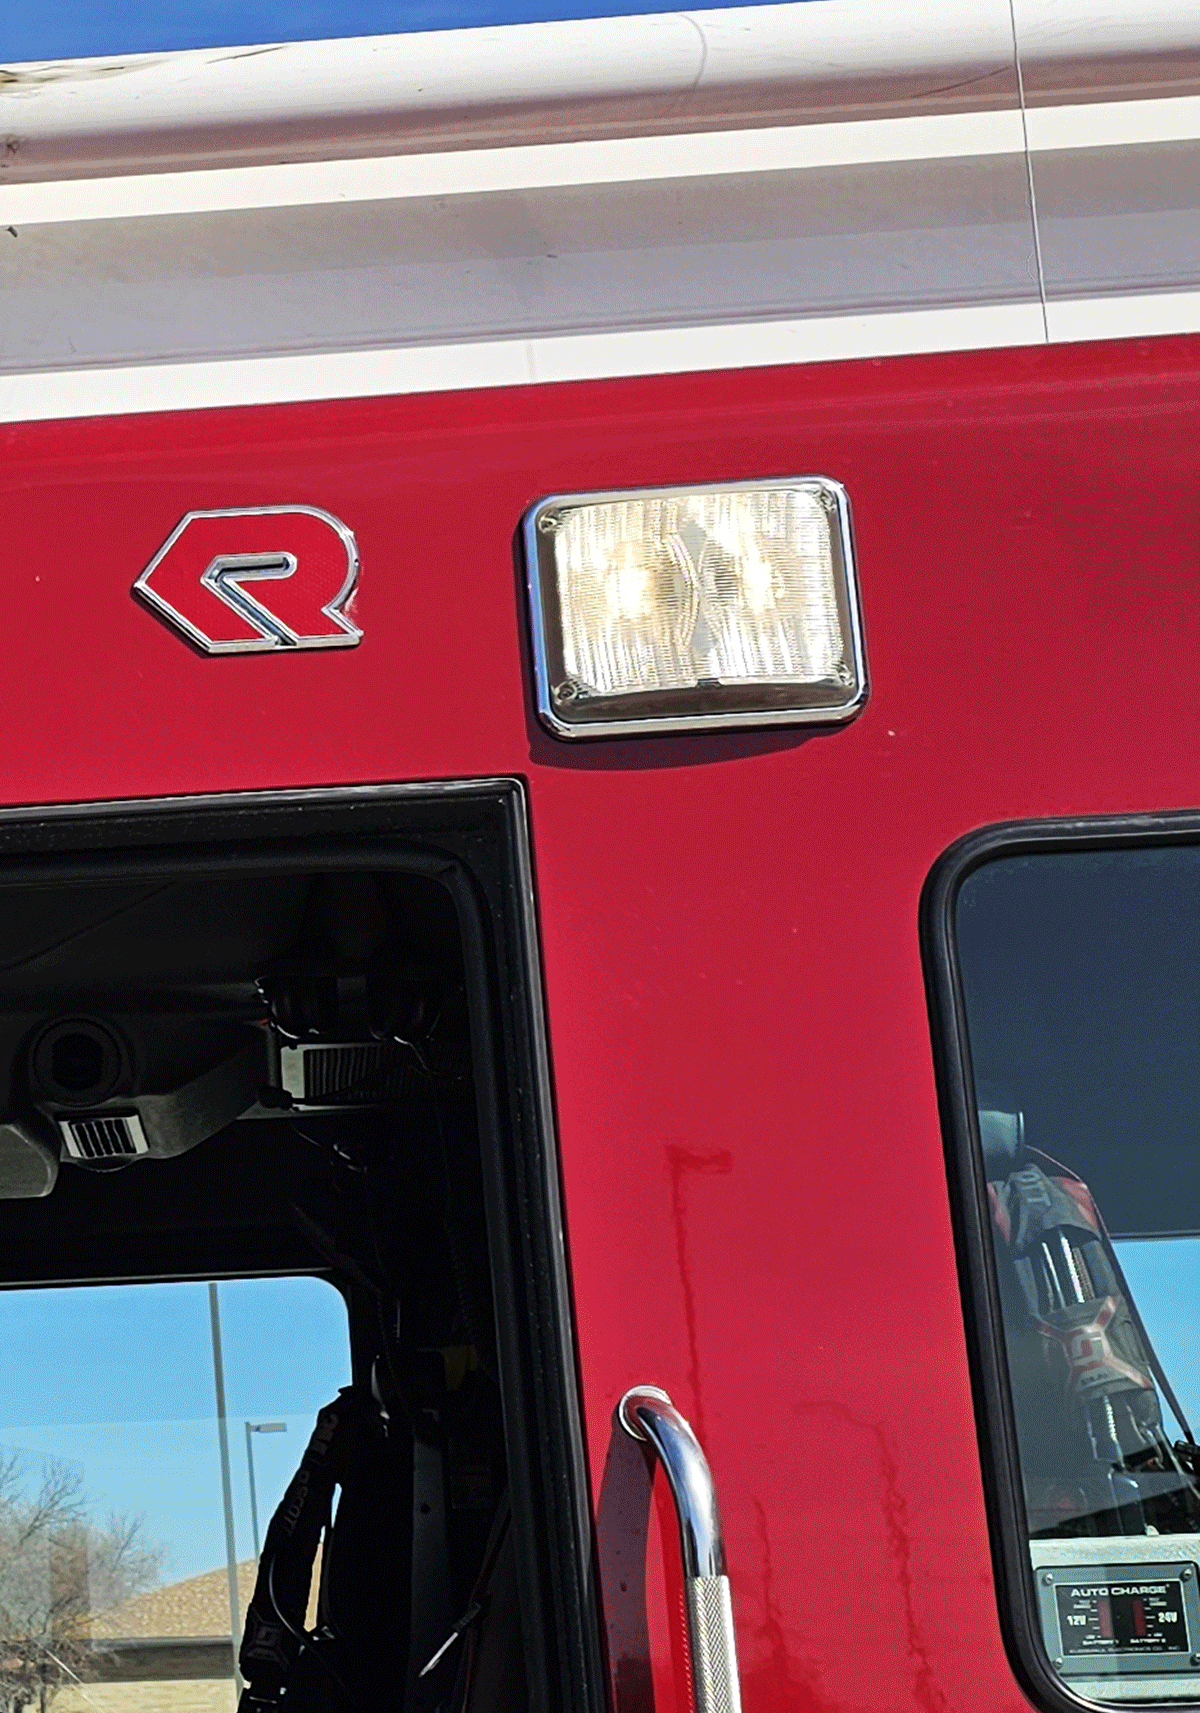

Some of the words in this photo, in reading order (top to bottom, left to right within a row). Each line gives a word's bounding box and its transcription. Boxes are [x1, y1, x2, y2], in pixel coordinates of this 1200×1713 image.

[1071, 1587, 1109, 1597] AUTO
[1111, 1586, 1167, 1596] CHARGE
[1067, 1615, 1087, 1626] 12V
